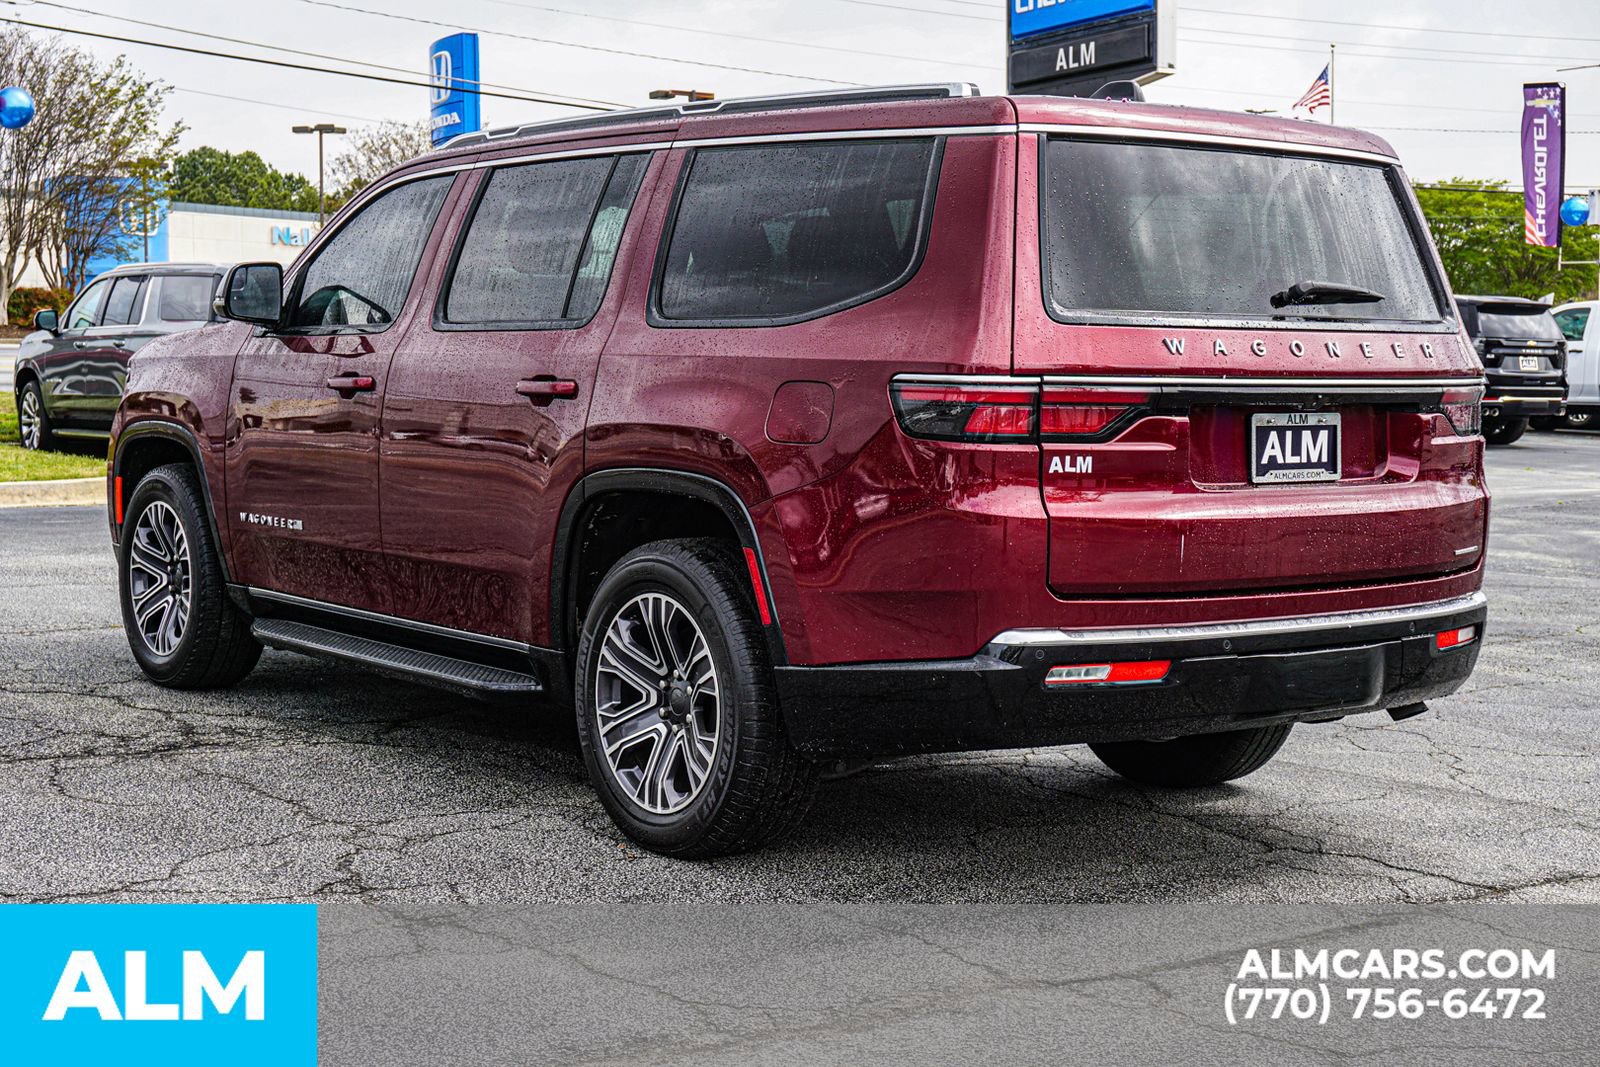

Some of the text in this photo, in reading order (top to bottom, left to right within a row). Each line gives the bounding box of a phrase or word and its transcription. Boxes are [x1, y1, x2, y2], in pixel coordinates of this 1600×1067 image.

[1056, 41, 1095, 71] ALM
[270, 226, 310, 247] Nal
[1163, 336, 1435, 359] WAGONEER
[1286, 413, 1309, 425] ALM
[1260, 429, 1329, 465] ALM
[1048, 455, 1093, 474] ALM
[1273, 471, 1322, 480] ALMCARSCOM
[239, 511, 293, 529] WAGONEER
